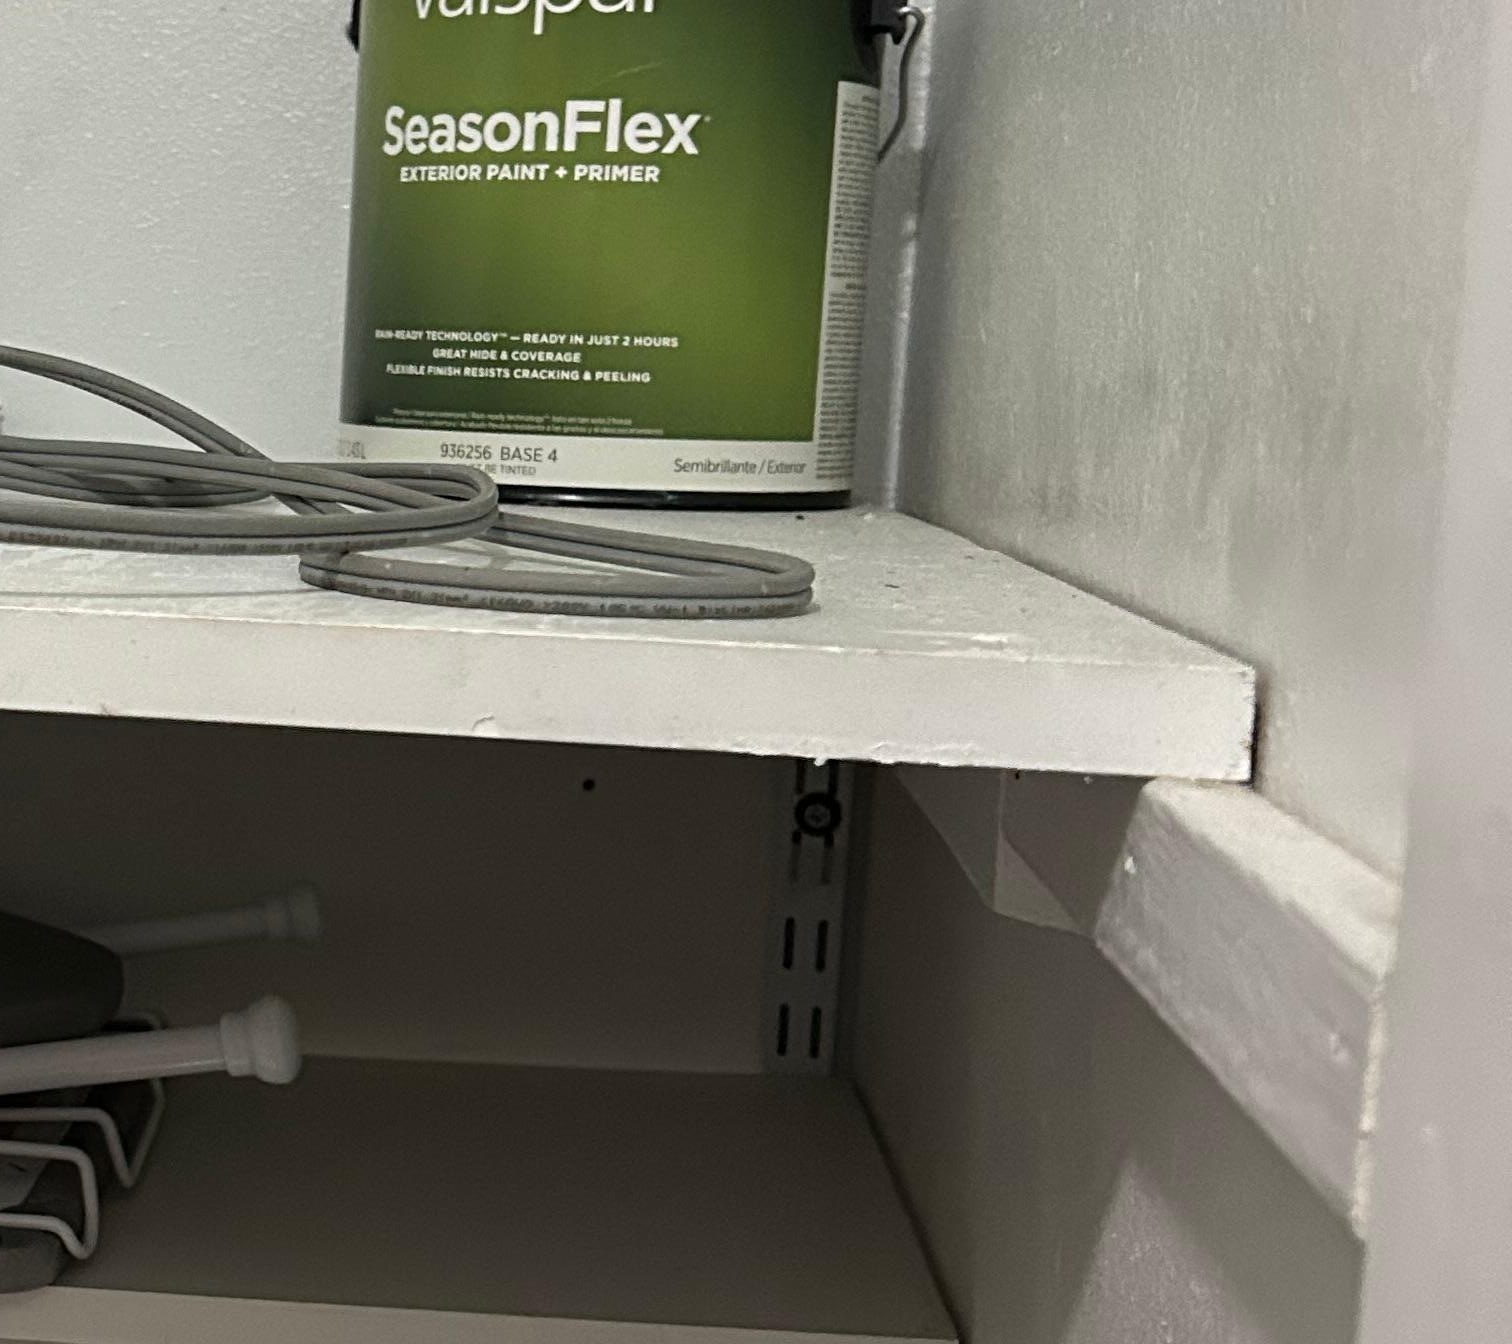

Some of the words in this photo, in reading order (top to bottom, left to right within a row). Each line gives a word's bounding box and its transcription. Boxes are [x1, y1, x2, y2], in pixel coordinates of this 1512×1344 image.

[382, 97, 702, 156] SeasonFlex
[399, 164, 482, 183] EXTERIOR
[486, 163, 550, 182] PAINT
[555, 168, 569, 179] +
[574, 164, 661, 183] PRIMER
[523, 333, 565, 345] READY
[569, 334, 584, 345] IN
[586, 335, 620, 346] JUST
[622, 336, 630, 346] 2
[633, 336, 679, 348] HOURS
[432, 348, 467, 359] GREAT
[470, 349, 497, 361] HIDE
[500, 350, 508, 360] &
[510, 350, 581, 364] COVERAGE
[427, 364, 462, 377] FINISH
[464, 365, 511, 379] RESISTS
[513, 367, 580, 381] CRACKING
[595, 371, 651, 383] PEELING
[439, 443, 492, 460] 936256
[500, 444, 543, 463] BASE
[547, 448, 559, 463] 4
[674, 457, 757, 475] Semibrillante
